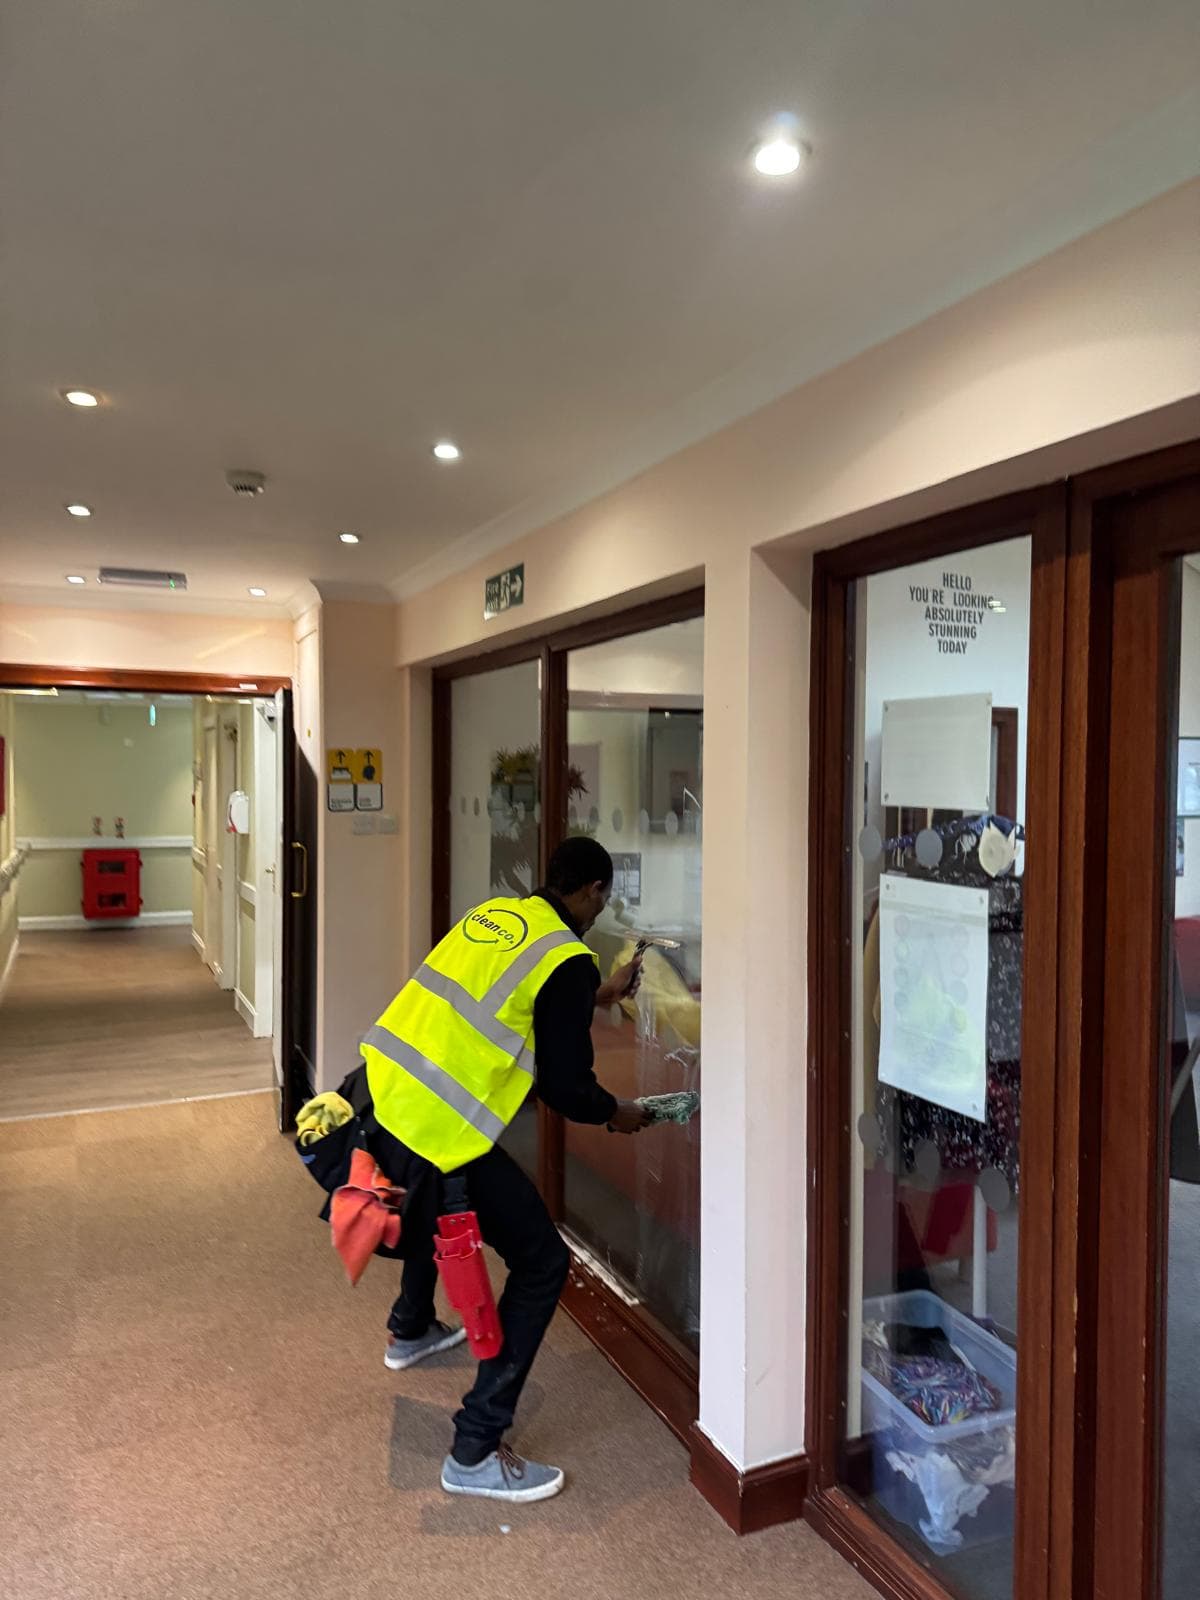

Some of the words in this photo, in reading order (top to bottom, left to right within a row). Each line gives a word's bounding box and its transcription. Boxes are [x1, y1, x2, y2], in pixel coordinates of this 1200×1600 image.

[943, 572, 972, 591] HELLO
[953, 592, 994, 610] LOOKING
[925, 606, 984, 624] ABSOLUTELY
[929, 623, 977, 639] STUNNING
[938, 639, 967, 655] TODAY
